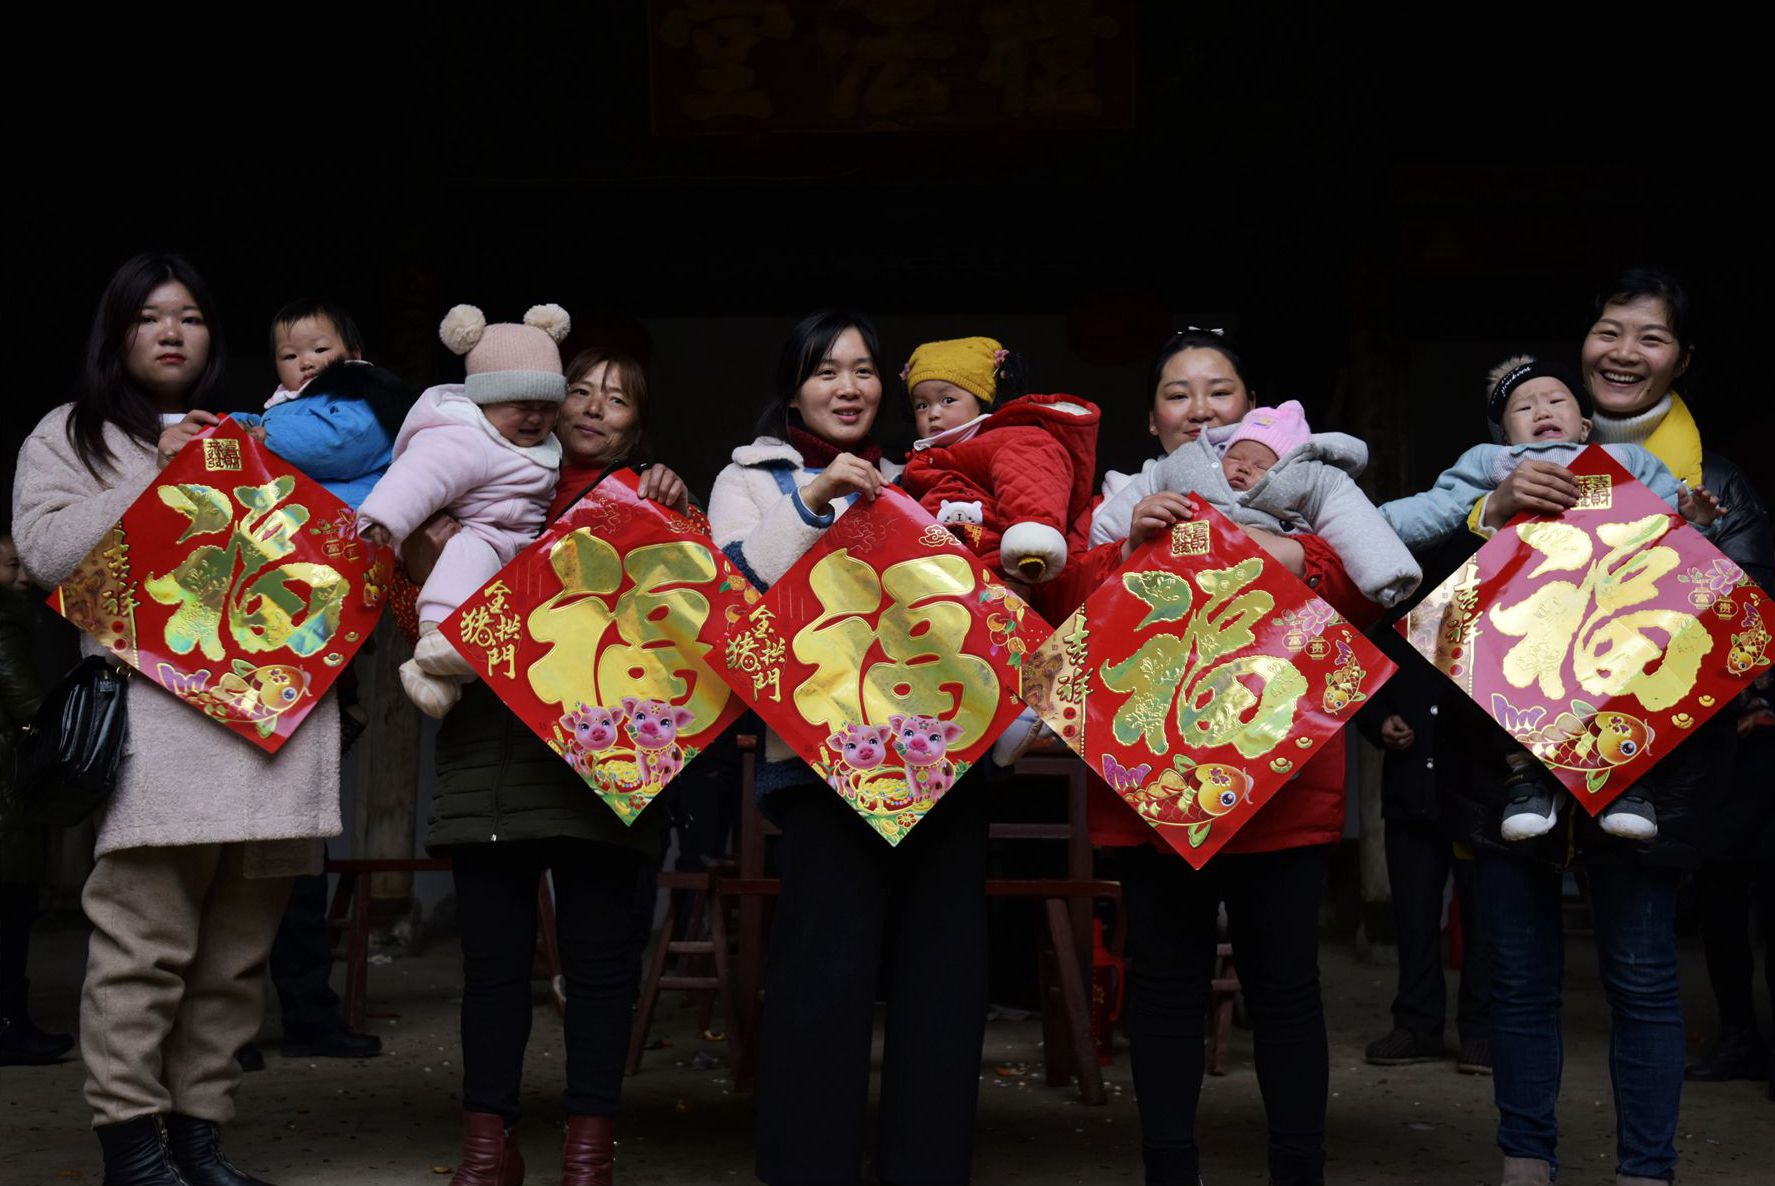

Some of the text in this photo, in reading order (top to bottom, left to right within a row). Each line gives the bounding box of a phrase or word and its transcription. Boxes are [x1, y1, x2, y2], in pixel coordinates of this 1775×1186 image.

[145, 475, 350, 662] 福
[527, 526, 732, 737] 福
[793, 548, 1000, 752] 福
[1100, 557, 1308, 759] 福
[1489, 514, 1714, 712] 福
